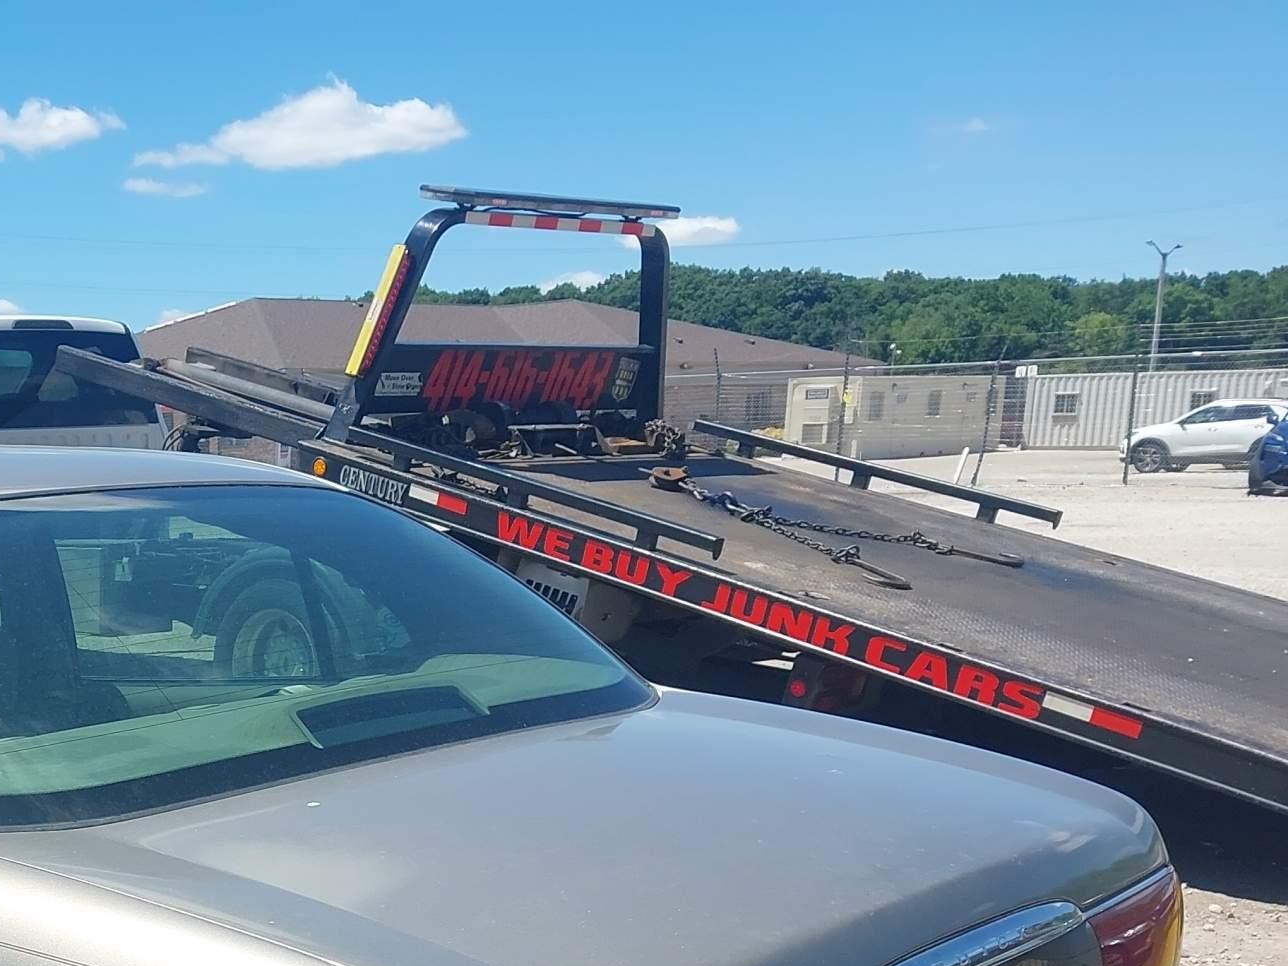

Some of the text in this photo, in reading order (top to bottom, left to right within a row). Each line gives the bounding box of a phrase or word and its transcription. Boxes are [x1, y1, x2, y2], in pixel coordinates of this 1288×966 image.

[339, 465, 409, 504] CENTURY
[496, 511, 1046, 721] WE BUY JUNK CARS
